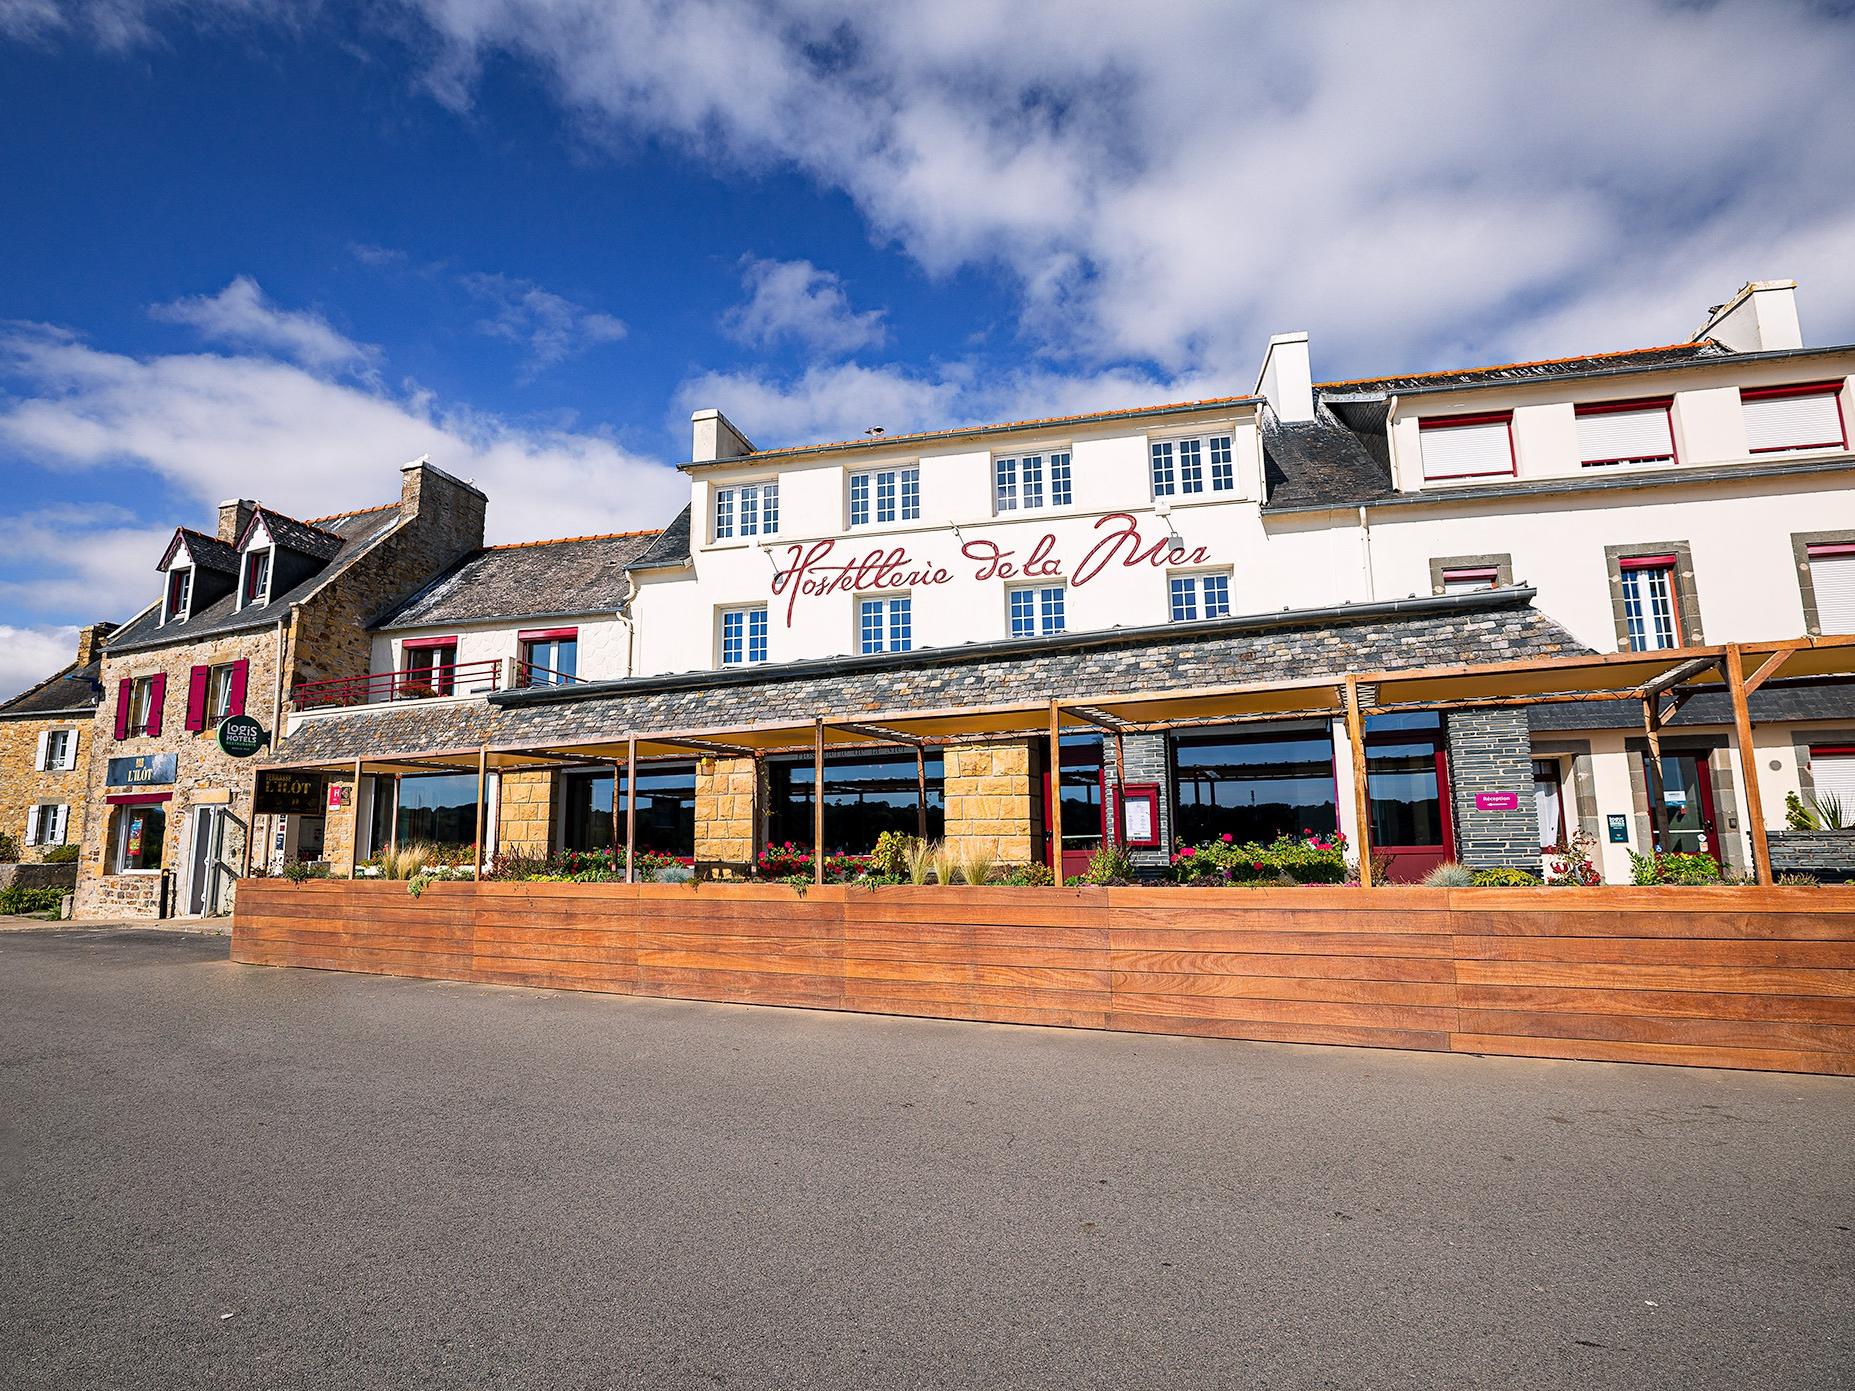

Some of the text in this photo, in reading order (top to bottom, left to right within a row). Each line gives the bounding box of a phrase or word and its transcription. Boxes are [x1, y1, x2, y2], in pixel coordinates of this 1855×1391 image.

[771, 539, 953, 628] Hostellerie
[1023, 534, 1063, 577] la
[1071, 513, 1211, 587] Mer
[333, 789, 340, 797] H
